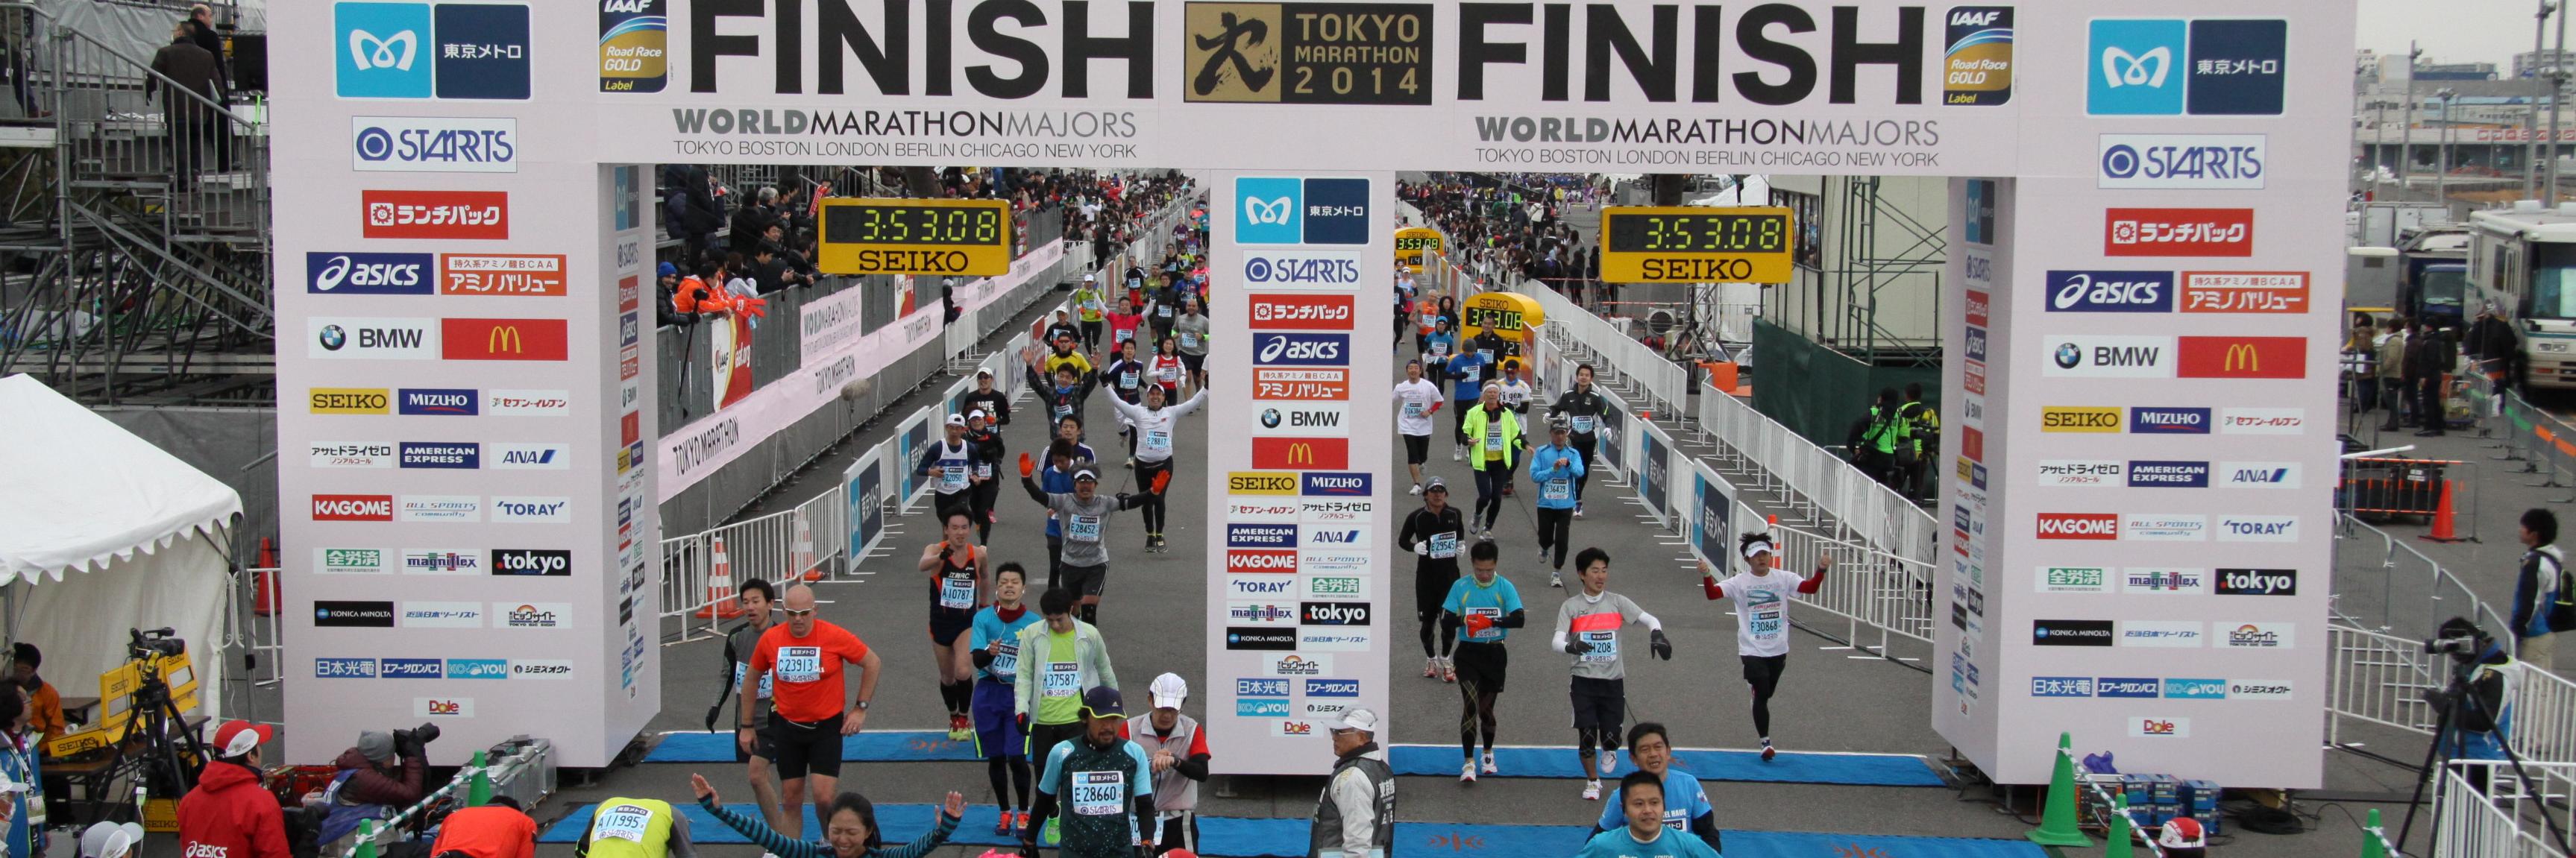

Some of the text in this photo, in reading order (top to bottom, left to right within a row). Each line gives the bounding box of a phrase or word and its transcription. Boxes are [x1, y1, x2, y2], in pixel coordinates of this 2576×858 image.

[604, 0, 653, 12] IAAF
[1951, 12, 2000, 25] IAAF
[1295, 13, 1419, 42] TOKYO
[444, 44, 521, 59] 東京メトロ
[607, 46, 662, 57] Road Race
[690, 0, 1154, 99] FINISH
[1295, 45, 1419, 63] MARATHON
[1457, 2, 1925, 105] FINISH
[605, 59, 641, 71] GOLD
[1952, 60, 2007, 69] Road Race
[2196, 60, 2277, 75] 東京メトロ
[606, 81, 633, 89] Label
[1295, 66, 1418, 95] 2014
[1949, 72, 1985, 84] GOLD
[1948, 94, 1976, 103] Label
[673, 141, 1137, 158] TOKYO BOSTON LONDON BERLIN CHICAGO NEW YORK
[1475, 148, 1939, 166] TOKYO BOSTON LONDON BERLIN CHICAGO NEW YORK
[398, 205, 500, 225] ランチパック
[1309, 206, 1363, 216] 東京メトロ
[2140, 223, 2244, 243] ランチパック
[858, 250, 968, 272] SEIKO
[351, 262, 420, 286] asics
[1642, 259, 1752, 280] SEIKO
[2089, 281, 2160, 304] asics
[1480, 299, 1509, 310] SEIKO
[1275, 304, 1348, 320] ランチパック
[359, 329, 423, 348] BMW
[1286, 341, 1339, 359] asics
[2093, 347, 2159, 366] BMW
[312, 393, 387, 409] SEIKO
[409, 393, 468, 407] MIZUHO
[1291, 411, 1340, 427] BMW
[2044, 412, 2118, 427] SEIKO
[2141, 411, 2200, 424] MIZUHO
[312, 446, 391, 457] アサヒドライゼロ
[404, 447, 475, 455] AMERICAN
[673, 416, 739, 476] TOKYO MARATHON
[404, 455, 463, 464] EXPRESS
[503, 450, 537, 464] ANA
[2040, 464, 2119, 475] アサヒドライゼロ
[2133, 466, 2205, 474] AMERICAN
[2232, 469, 2268, 482] ANA
[1231, 477, 1295, 490] SEIKO
[1311, 477, 1363, 488] MIZUHO
[2133, 474, 2192, 482] EXPRESS
[315, 500, 391, 516] KAGOME
[1302, 502, 1371, 511] アサヒドライゼロ
[2040, 519, 2115, 534] KAGOME
[1313, 531, 1342, 543] ANA
[327, 550, 380, 566] 全労済
[406, 553, 477, 571] magniflex
[1230, 555, 1295, 568] KAGOME
[2049, 568, 2102, 585] 全労済
[2129, 572, 2199, 590] magniflex
[1313, 578, 1359, 593] 全労済
[1231, 605, 1293, 620] magniflex
[317, 660, 375, 675] 日本光電
[383, 663, 440, 674] エアーサロンパス
[524, 665, 571, 673] シミズオクト
[1238, 681, 1289, 694] 日本光電
[1307, 684, 1357, 693] エアーサロンパス
[2033, 680, 2090, 694] 日本光電
[2098, 682, 2157, 693] エアーサロンパス
[2243, 684, 2291, 693] シミズオクト
[430, 700, 459, 713] Dole
[1284, 722, 1310, 734] Dole
[2143, 719, 2174, 732] Dole
[57, 736, 96, 752] SEIKO
